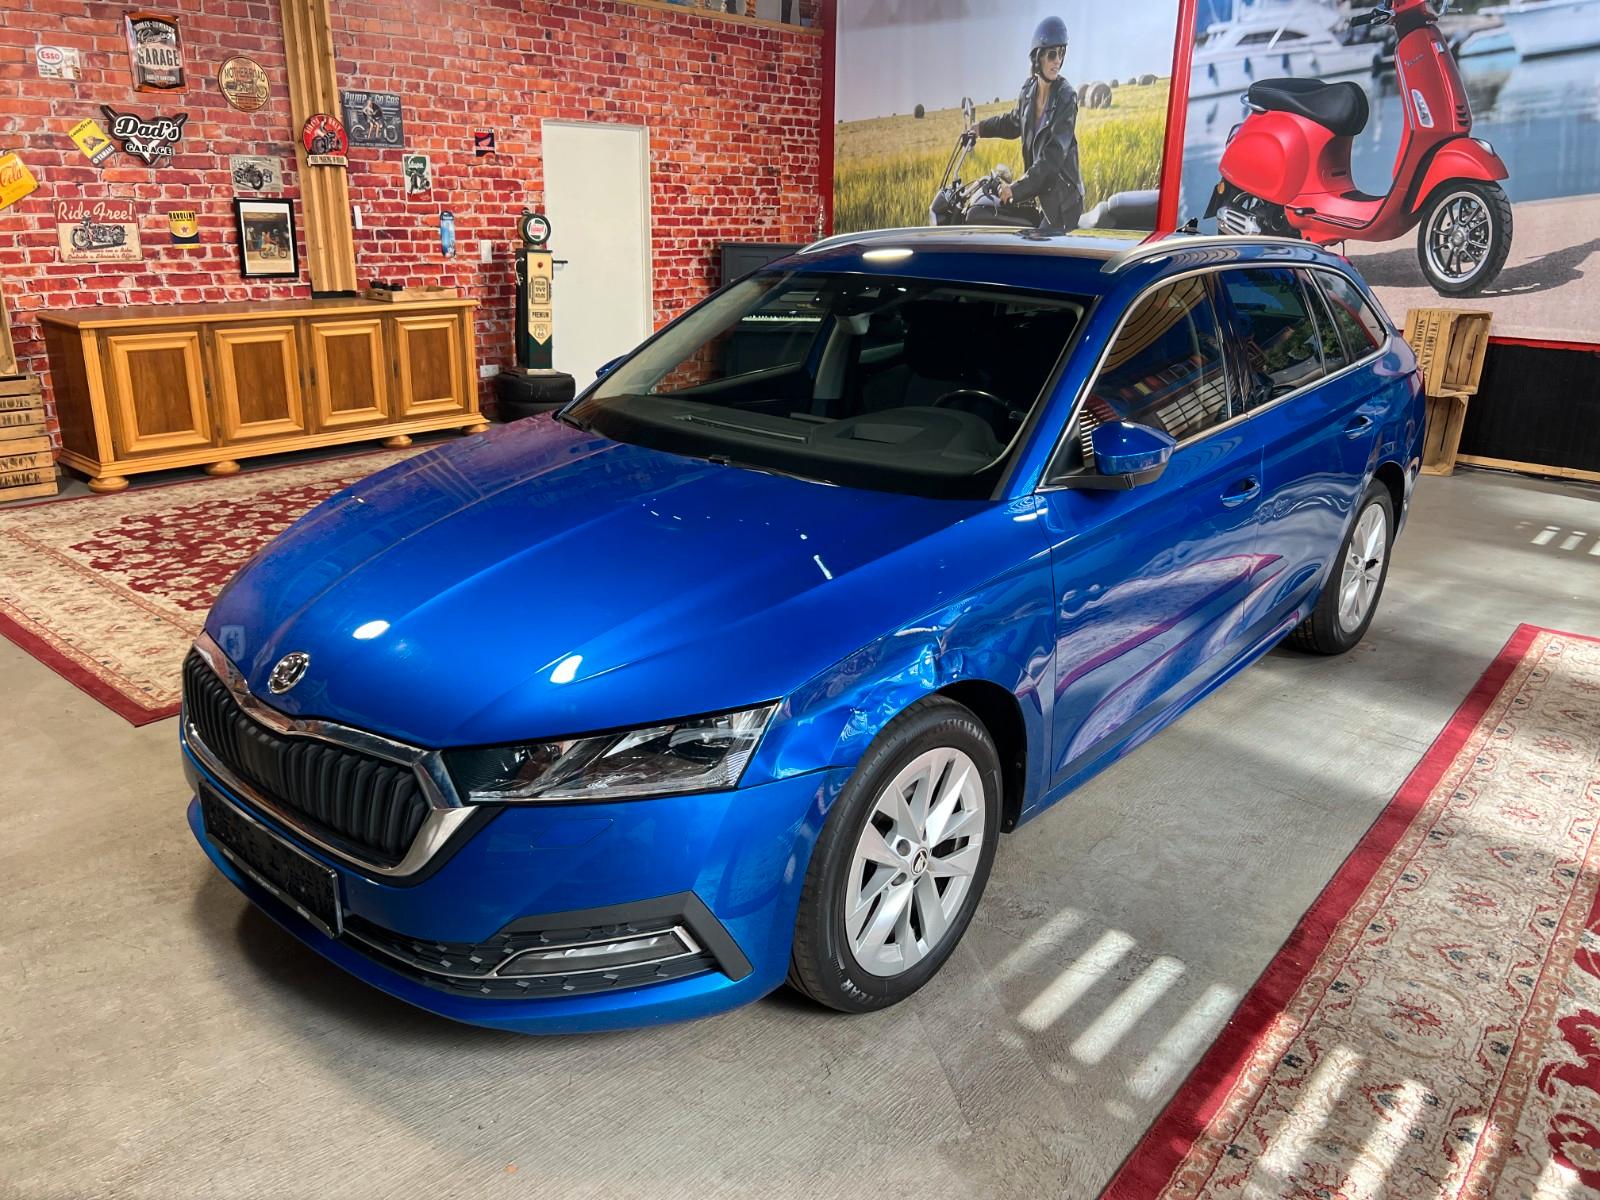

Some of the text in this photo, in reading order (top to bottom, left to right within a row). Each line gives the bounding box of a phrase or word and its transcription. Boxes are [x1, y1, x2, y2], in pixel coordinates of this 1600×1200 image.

[138, 47, 180, 67] GARAGE
[115, 117, 180, 141] Dad's
[127, 143, 172, 155] GARAGE
[57, 201, 133, 221] Ride Free!
